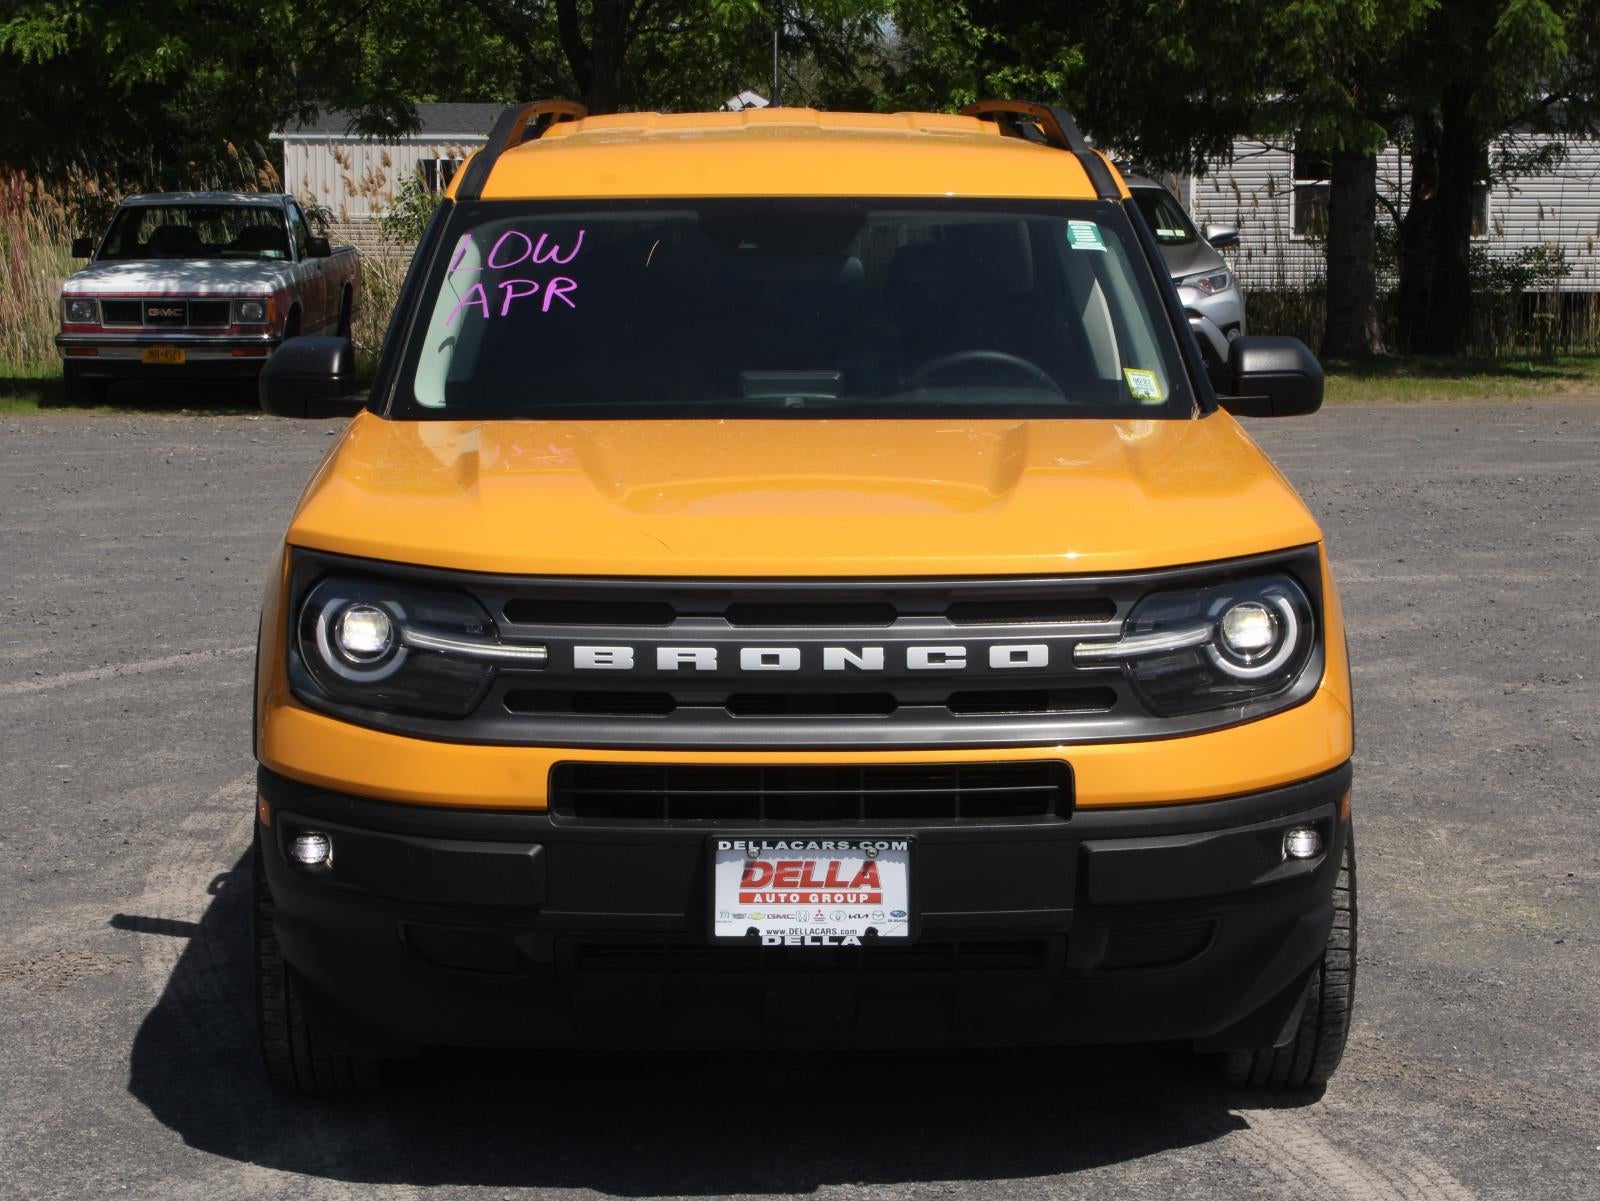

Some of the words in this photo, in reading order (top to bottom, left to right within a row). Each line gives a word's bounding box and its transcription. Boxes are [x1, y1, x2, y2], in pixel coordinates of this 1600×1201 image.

[448, 230, 585, 272] LOW
[446, 277, 578, 326] APR
[148, 308, 183, 317] GMC
[573, 644, 1049, 671] BRONCO
[718, 841, 908, 850] DELLACARS.COM
[740, 860, 881, 889] DELLA
[753, 893, 800, 903] AUTO
[809, 893, 869, 903] GROUP
[766, 928, 857, 936] www.DELLACARS.com
[761, 935, 862, 946] DELLA
